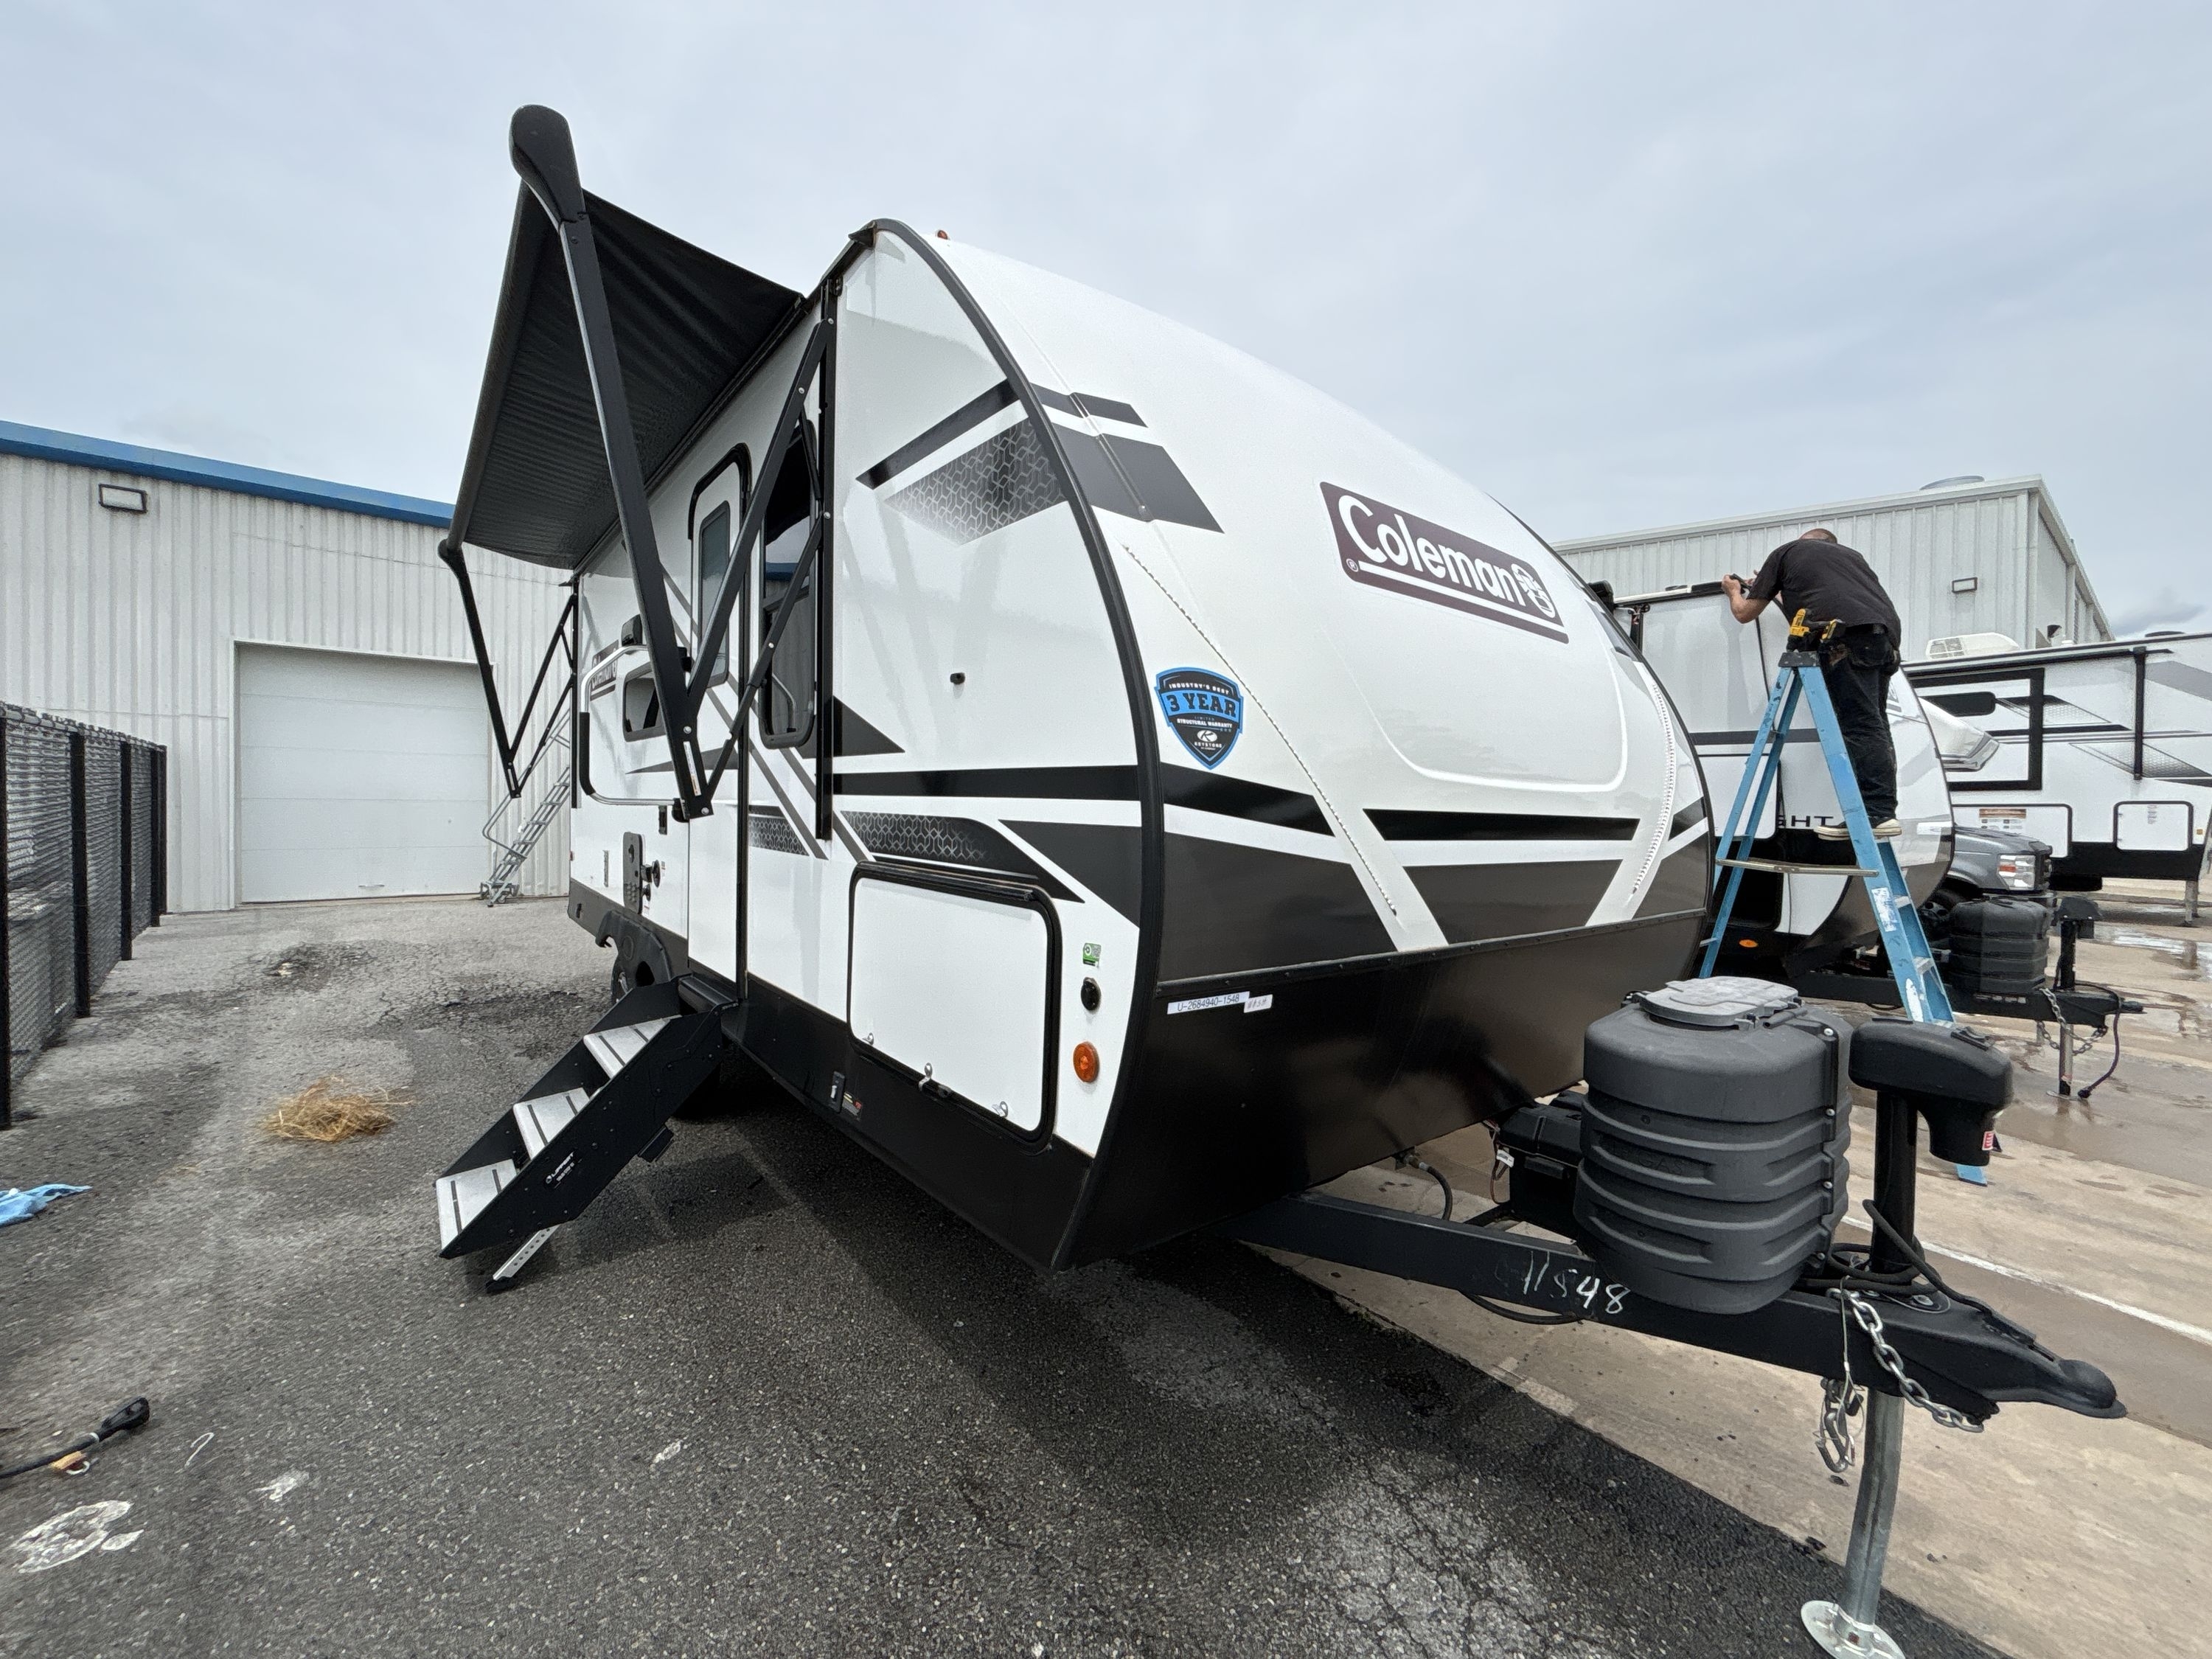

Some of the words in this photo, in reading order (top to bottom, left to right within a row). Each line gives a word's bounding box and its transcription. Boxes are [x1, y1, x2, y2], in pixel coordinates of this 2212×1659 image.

[1338, 495, 1526, 607] Coleman
[1166, 695, 1180, 712] 3
[1182, 693, 1236, 717] YEAR
